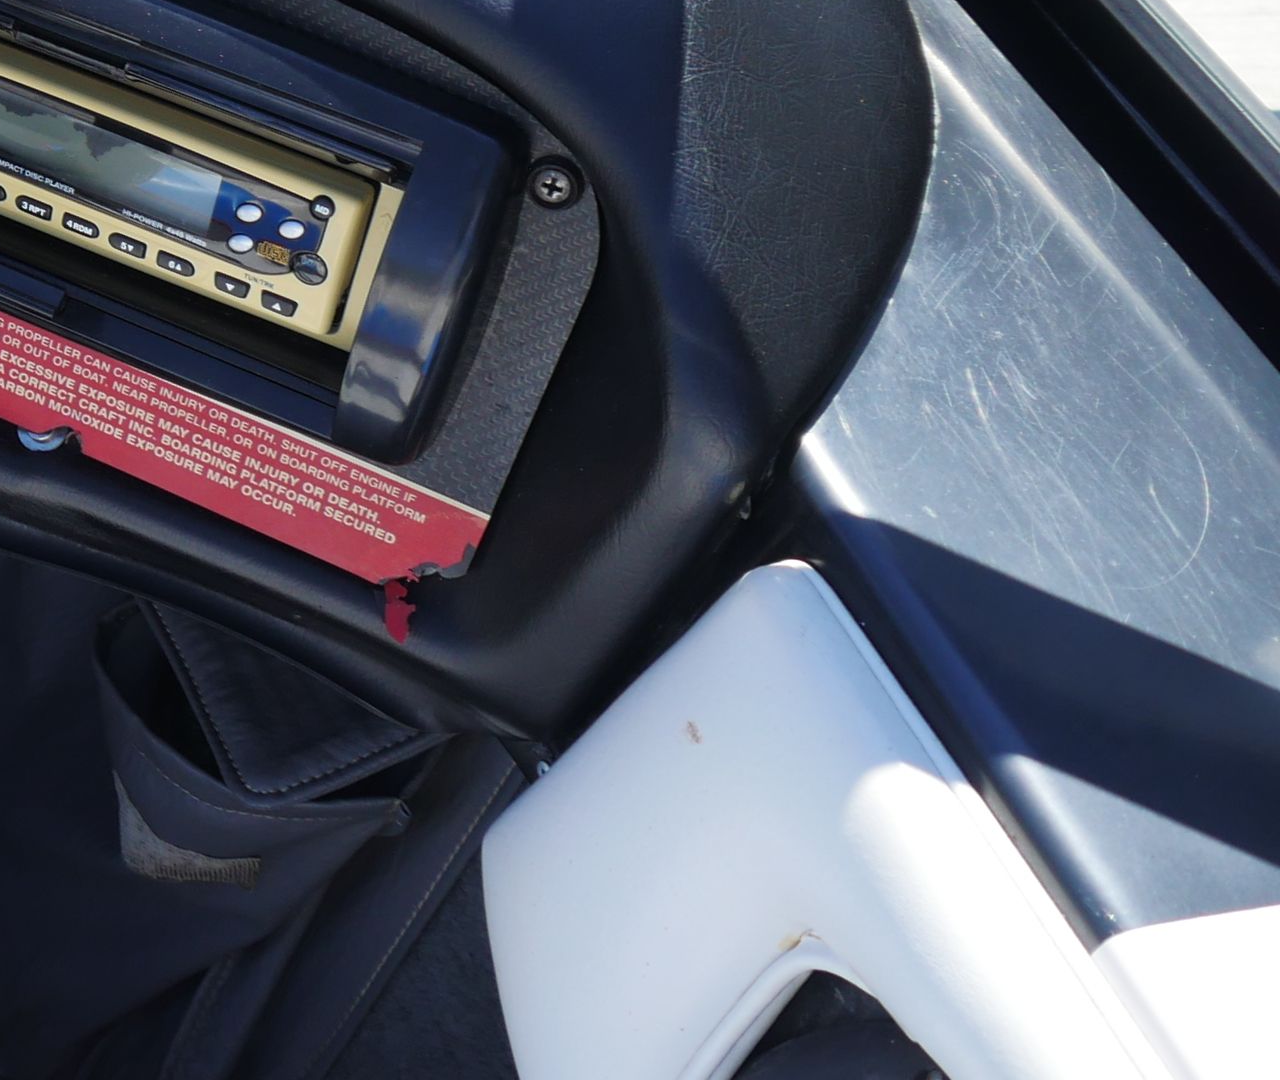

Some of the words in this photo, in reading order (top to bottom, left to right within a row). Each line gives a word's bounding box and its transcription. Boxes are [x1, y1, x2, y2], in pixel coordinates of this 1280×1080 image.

[21, 201, 28, 209] 3
[29, 204, 46, 216] RPT
[25, 169, 44, 182] DISC
[45, 177, 75, 194] PLAYER
[66, 220, 72, 228] 4
[73, 222, 93, 236] RDM
[315, 204, 329, 215] MD
[1, 334, 22, 349] OR
[22, 343, 51, 361] OUT
[51, 355, 71, 369] OF
[71, 363, 108, 387] BOAT.
[111, 380, 149, 404] NEAR
[148, 396, 230, 440] PROPELLER.
[231, 433, 254, 449] OR
[255, 443, 278, 460] ON
[278, 453, 350, 492] BOARDING
[350, 484, 427, 524] PLATFORM
[6, 321, 82, 360] PROPELLER
[82, 354, 111, 373] CAN
[111, 367, 157, 393] CAUSE
[158, 386, 207, 413] INJURY
[207, 407, 229, 424] OR
[229, 416, 277, 445] DEATH.
[279, 438, 319, 461] SHUT
[319, 456, 349, 473] OFF
[348, 468, 402, 499] ENGINE
[401, 491, 417, 503] IF
[7, 368, 77, 404] CORRECT
[77, 398, 127, 425] CRAFT
[127, 419, 156, 441] INC.
[159, 433, 238, 476] BOARDING
[238, 468, 322, 513] PLATFORM
[321, 505, 397, 545] SECURED
[47, 398, 125, 441] MONOXIDE
[124, 433, 205, 476] EXPOSURE
[205, 468, 240, 489] MAY
[239, 484, 296, 517] OCCUR.
[76, 382, 156, 425] EXPOSURE
[156, 417, 190, 439] MAY
[190, 433, 243, 463] CAUSE
[243, 455, 301, 487] INJURY
[301, 481, 326, 500] OR
[326, 492, 381, 525] DEATH.
